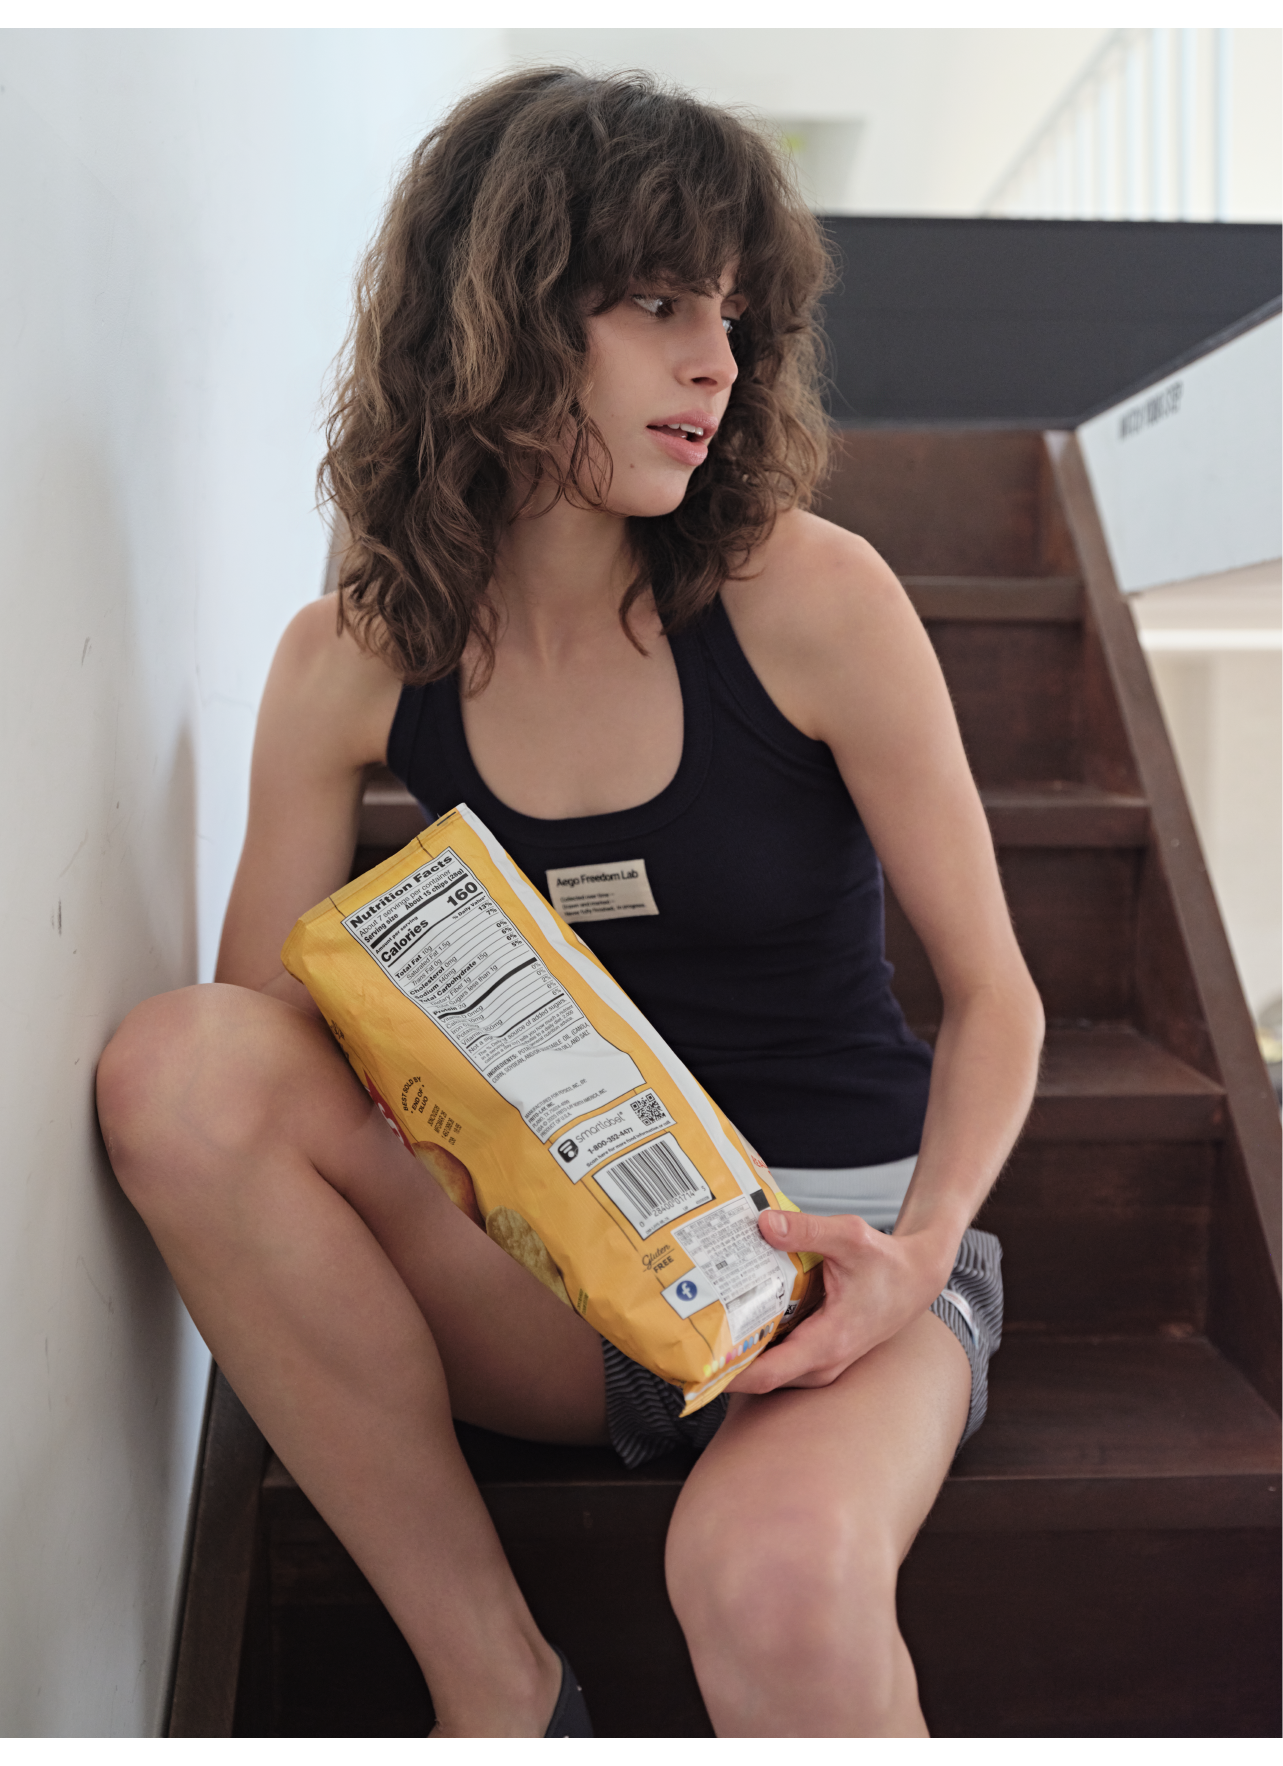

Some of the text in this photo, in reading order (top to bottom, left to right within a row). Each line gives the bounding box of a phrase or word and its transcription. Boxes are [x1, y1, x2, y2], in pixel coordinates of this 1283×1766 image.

[350, 856, 452, 928] Nutrition Facts
[557, 870, 638, 887] Aego Freedom Lab
[359, 920, 378, 937] About
[383, 897, 410, 917] servings
[410, 889, 421, 899] per
[422, 870, 450, 890] container
[364, 923, 387, 943] Serving
[386, 914, 398, 924] size
[404, 895, 423, 910] About
[432, 880, 448, 892] chips
[381, 882, 478, 962] Calories 160
[395, 902, 492, 978] Total Fat 10g 13%
[407, 957, 430, 980] Saturated
[429, 950, 439, 959] Fat
[438, 941, 451, 951] 1.5g
[437, 961, 476, 996] Carbohydrate
[477, 952, 488, 960] 15g
[410, 966, 445, 995] Cholesterol
[444, 956, 458, 967] 0mg
[412, 973, 426, 986] Trans
[425, 965, 434, 974] Fat
[439, 968, 456, 983] 140mg
[450, 991, 468, 1005] Sugars
[467, 981, 479, 991] less
[478, 971, 490, 982] than
[449, 983, 463, 996] Fiber
[507, 1025, 525, 1039] source
[532, 1008, 549, 1022] added
[468, 1044, 479, 1053] Not
[487, 1054, 517, 1078] INGREDIENTS:
[492, 1071, 506, 1083] CORN,
[403, 1079, 414, 1093] SOLD
[412, 1088, 423, 1110] END OF
[588, 1127, 633, 1154] 1-800-352-4477
[652, 1199, 674, 1217] 28400
[674, 1189, 695, 1204] 01714
[642, 1245, 670, 1270] Gluten
[653, 1256, 674, 1273] FREE
